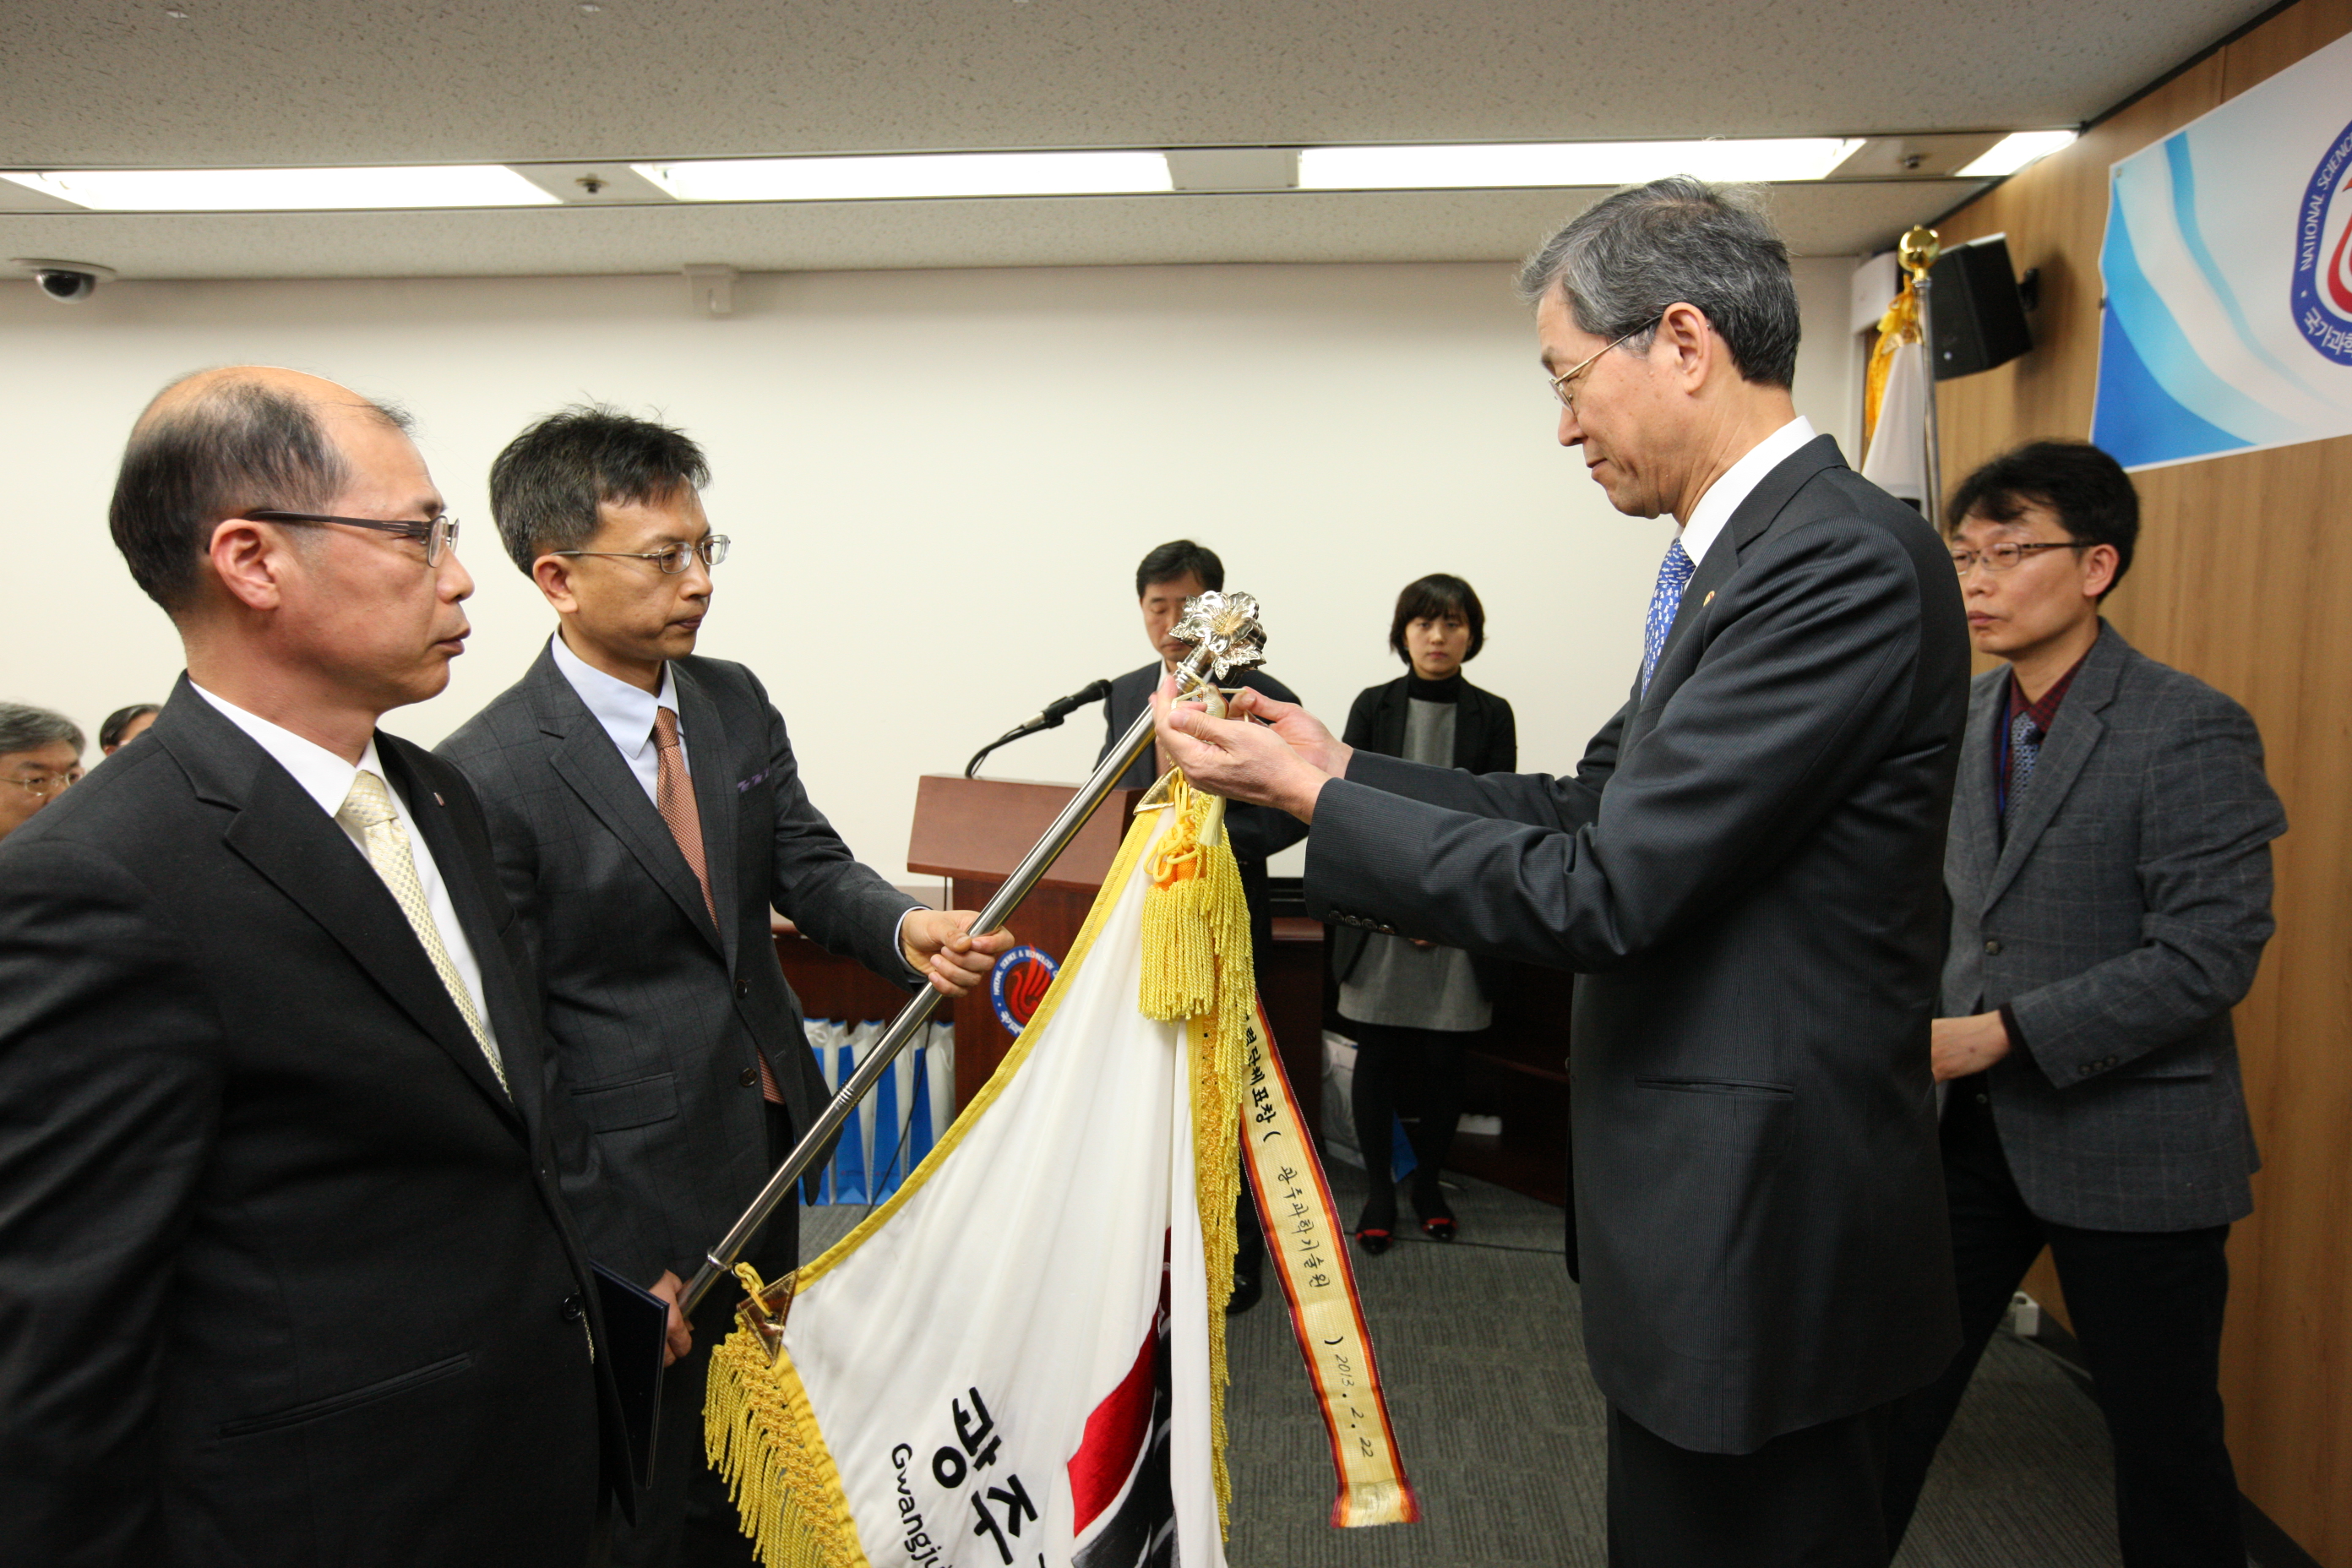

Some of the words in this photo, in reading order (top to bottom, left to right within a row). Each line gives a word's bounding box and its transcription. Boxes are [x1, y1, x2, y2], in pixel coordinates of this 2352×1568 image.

[2300, 193, 2325, 272] NATIONAL
[2317, 130, 2352, 191] SCIENC
[1359, 1436, 1374, 1458] 22
